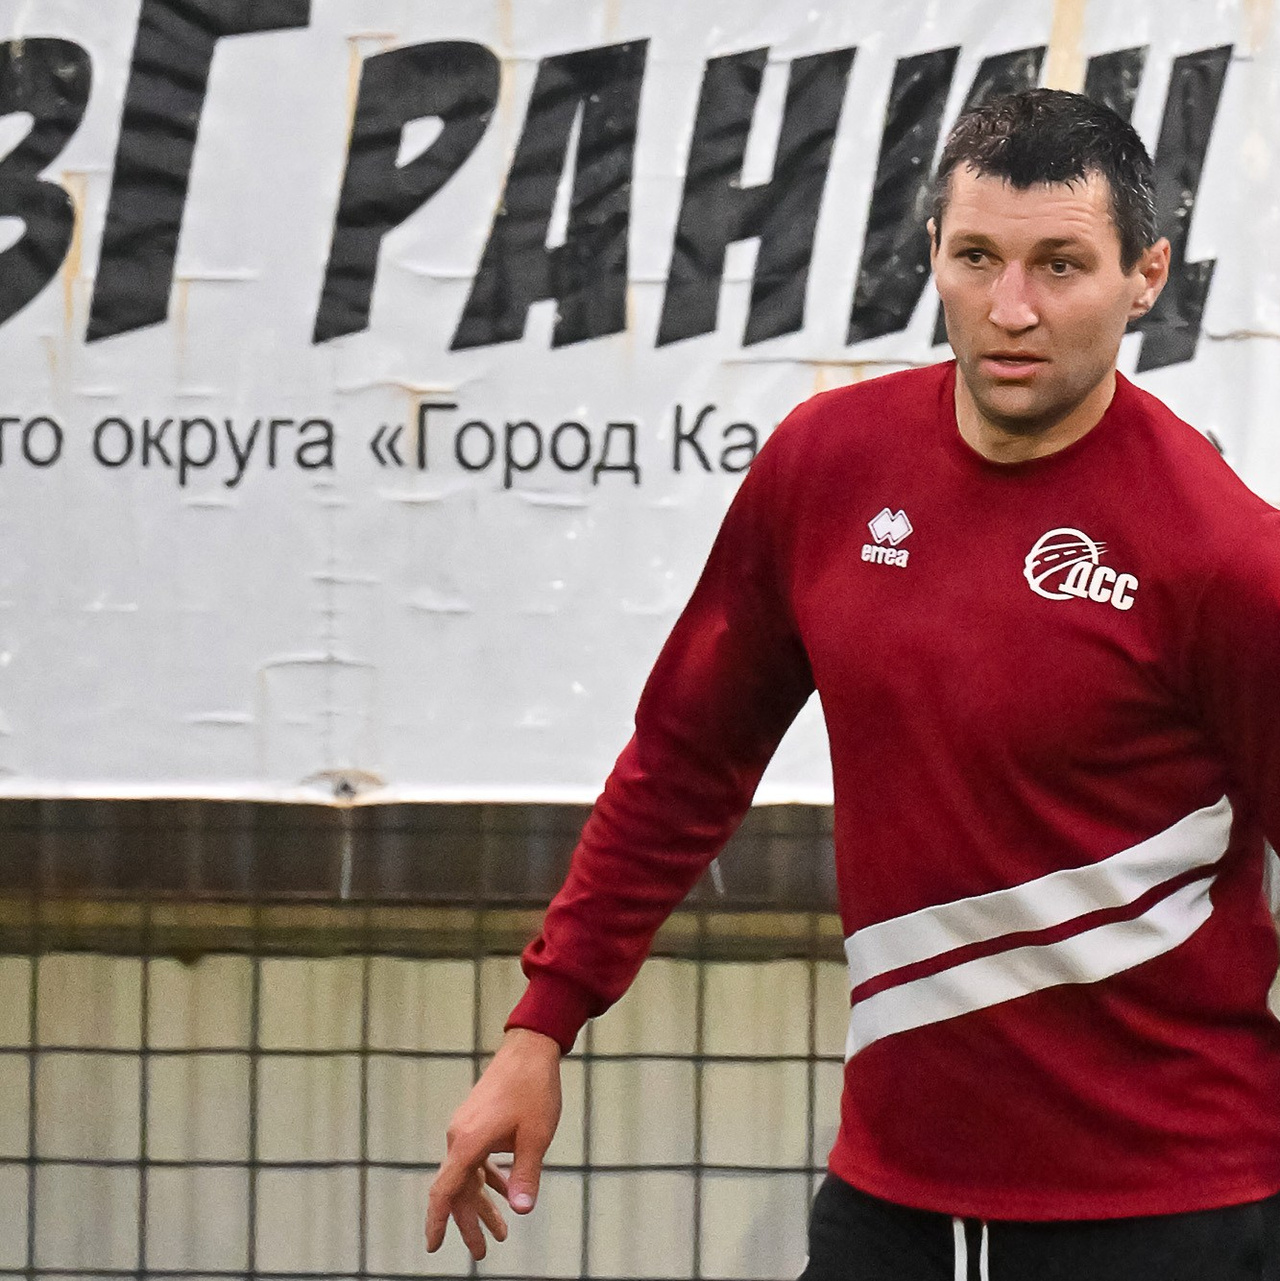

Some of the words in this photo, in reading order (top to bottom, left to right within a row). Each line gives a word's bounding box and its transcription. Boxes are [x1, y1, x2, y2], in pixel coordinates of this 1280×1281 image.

[92, 416, 334, 488] округа
[368, 401, 641, 490] «Город
[1057, 561, 1139, 611] ДСС
